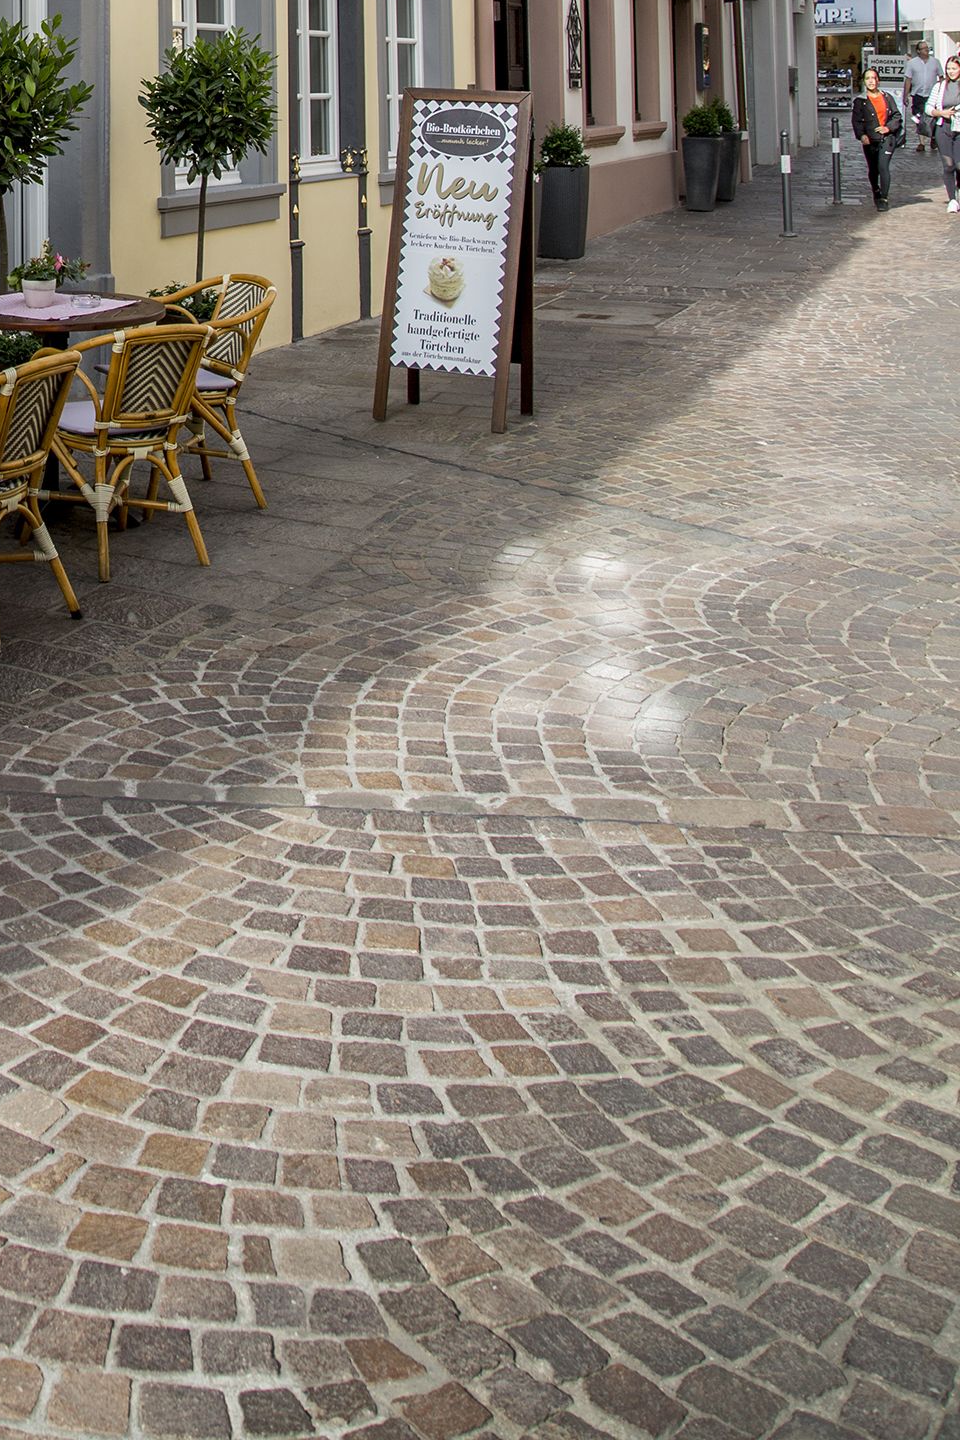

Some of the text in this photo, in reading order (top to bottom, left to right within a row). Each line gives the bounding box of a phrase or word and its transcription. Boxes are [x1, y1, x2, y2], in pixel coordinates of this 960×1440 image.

[426, 122, 501, 136] Bio-Brotkörbchen
[416, 161, 499, 202] Neu
[414, 200, 499, 232] Eröffnung
[413, 308, 477, 326] Traditionelle
[407, 323, 480, 343] handgefertigte
[420, 339, 464, 354] Törtchen
